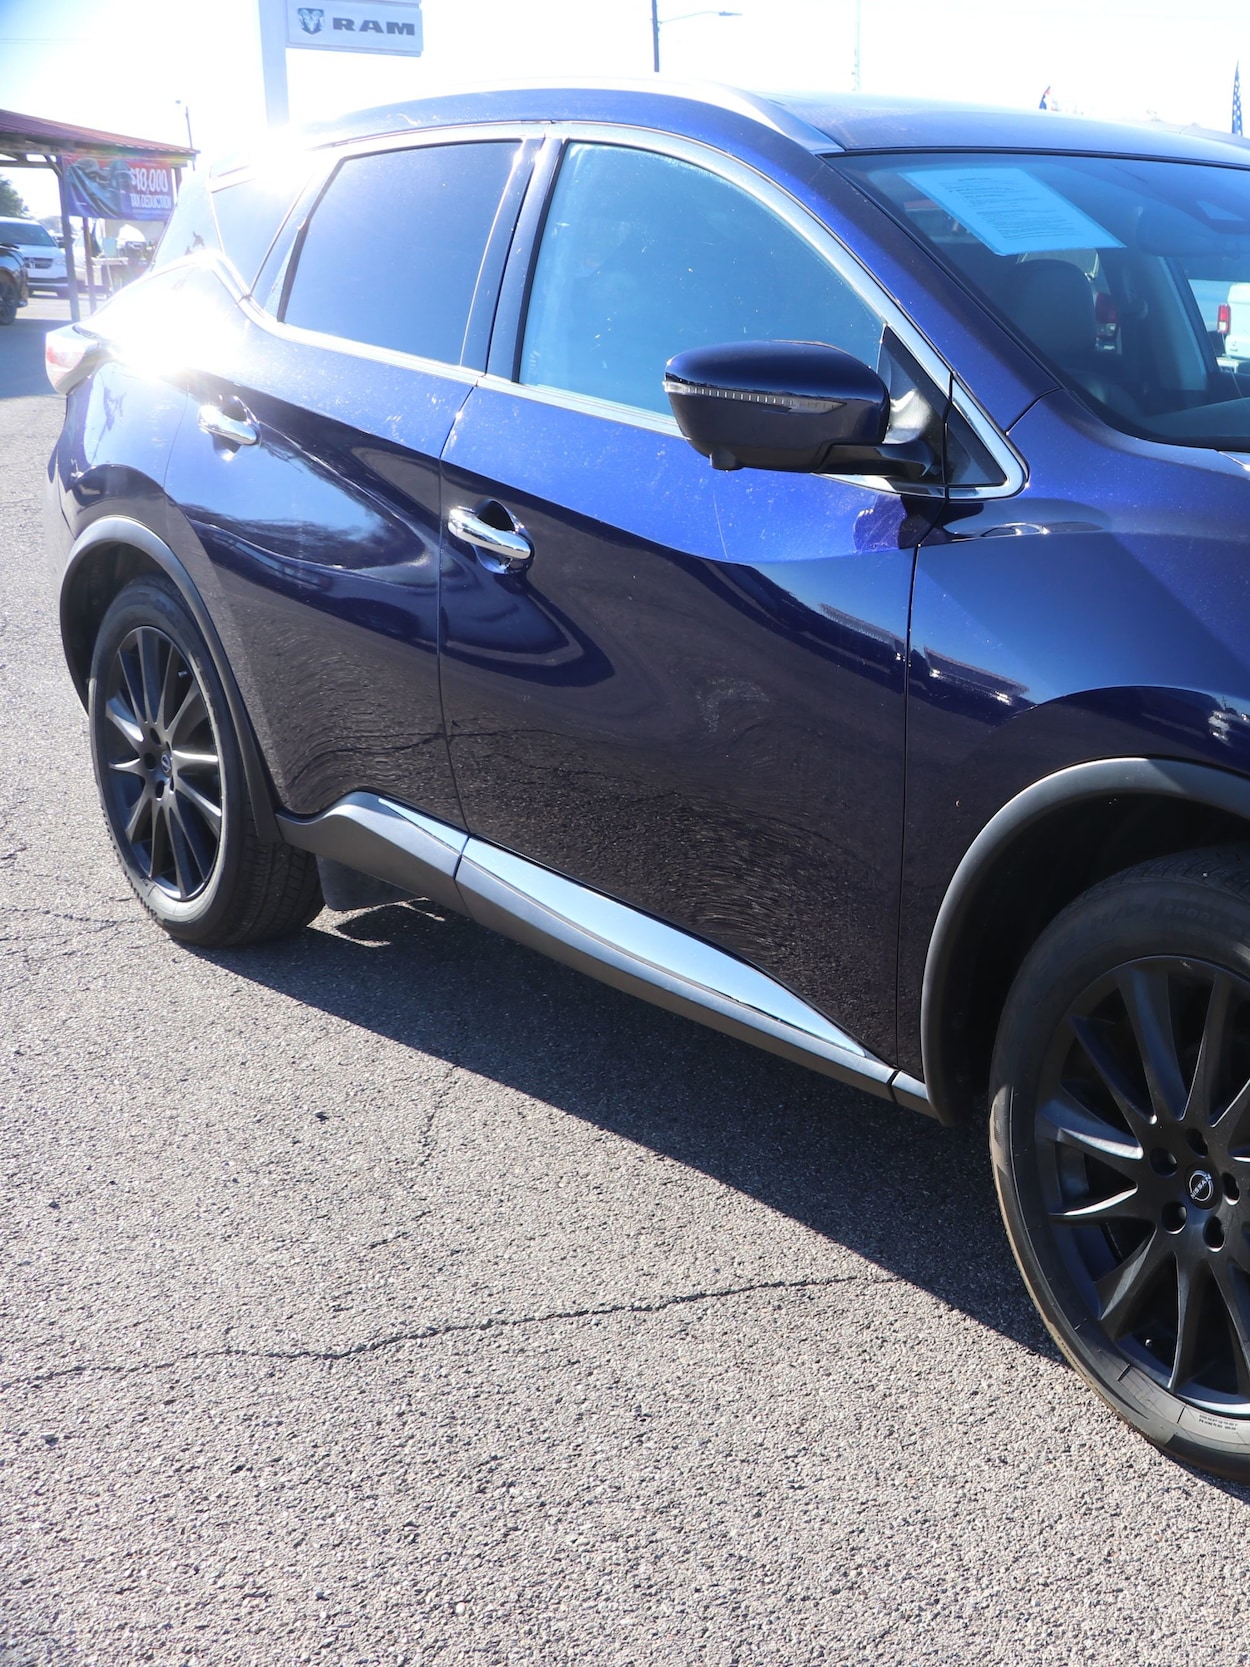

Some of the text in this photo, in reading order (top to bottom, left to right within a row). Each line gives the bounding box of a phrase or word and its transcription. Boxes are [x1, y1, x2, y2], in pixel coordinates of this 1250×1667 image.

[332, 17, 415, 36] RAM
[130, 193, 172, 209] TAX DEDUCTION
